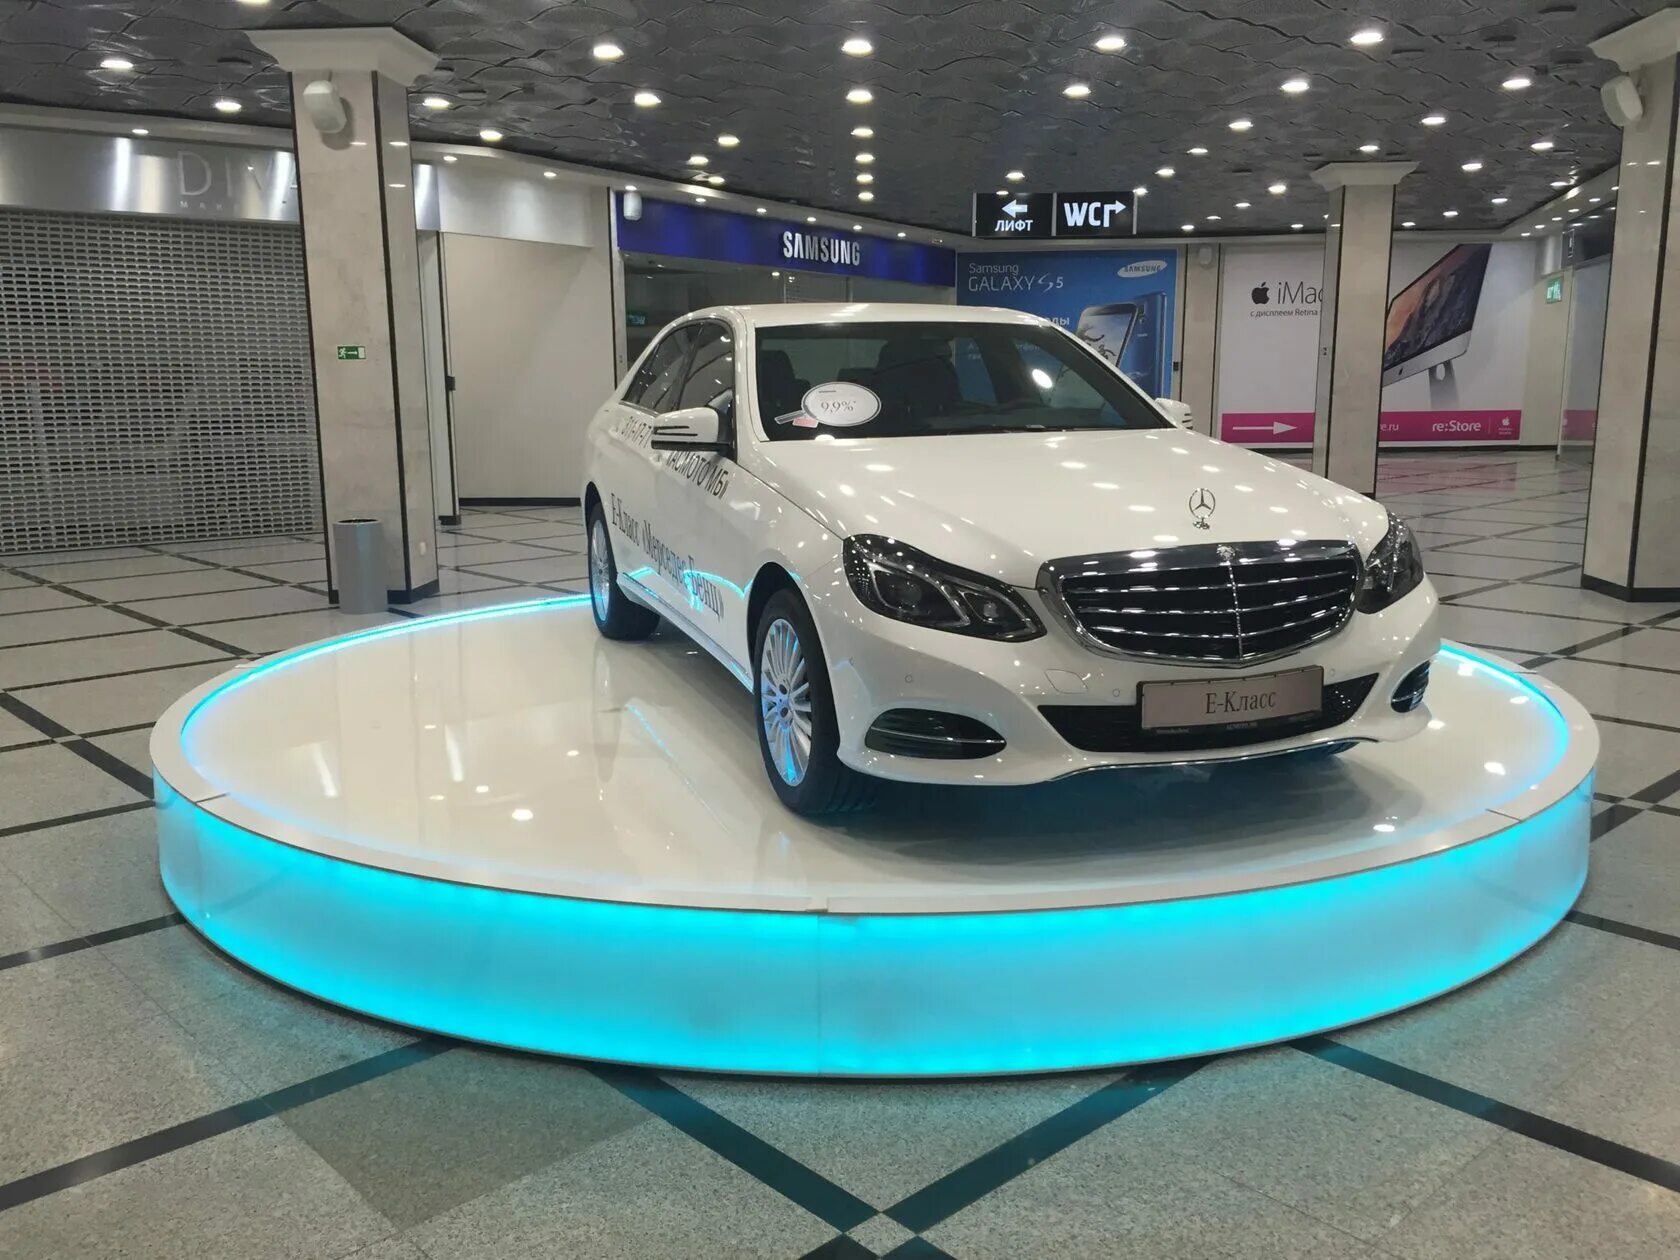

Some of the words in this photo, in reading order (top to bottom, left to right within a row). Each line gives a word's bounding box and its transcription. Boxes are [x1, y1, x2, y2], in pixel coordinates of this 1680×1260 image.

[994, 219, 1034, 232] ЛИФТ
[783, 230, 860, 266] SAMSUNG
[968, 262, 1019, 278] Samsung
[968, 275, 1033, 292] GALAXY
[1294, 308, 1319, 317] Retina
[1432, 420, 1481, 432] re:Store
[611, 492, 640, 547] Е-Класс
[1205, 691, 1277, 714] Е-Класс
